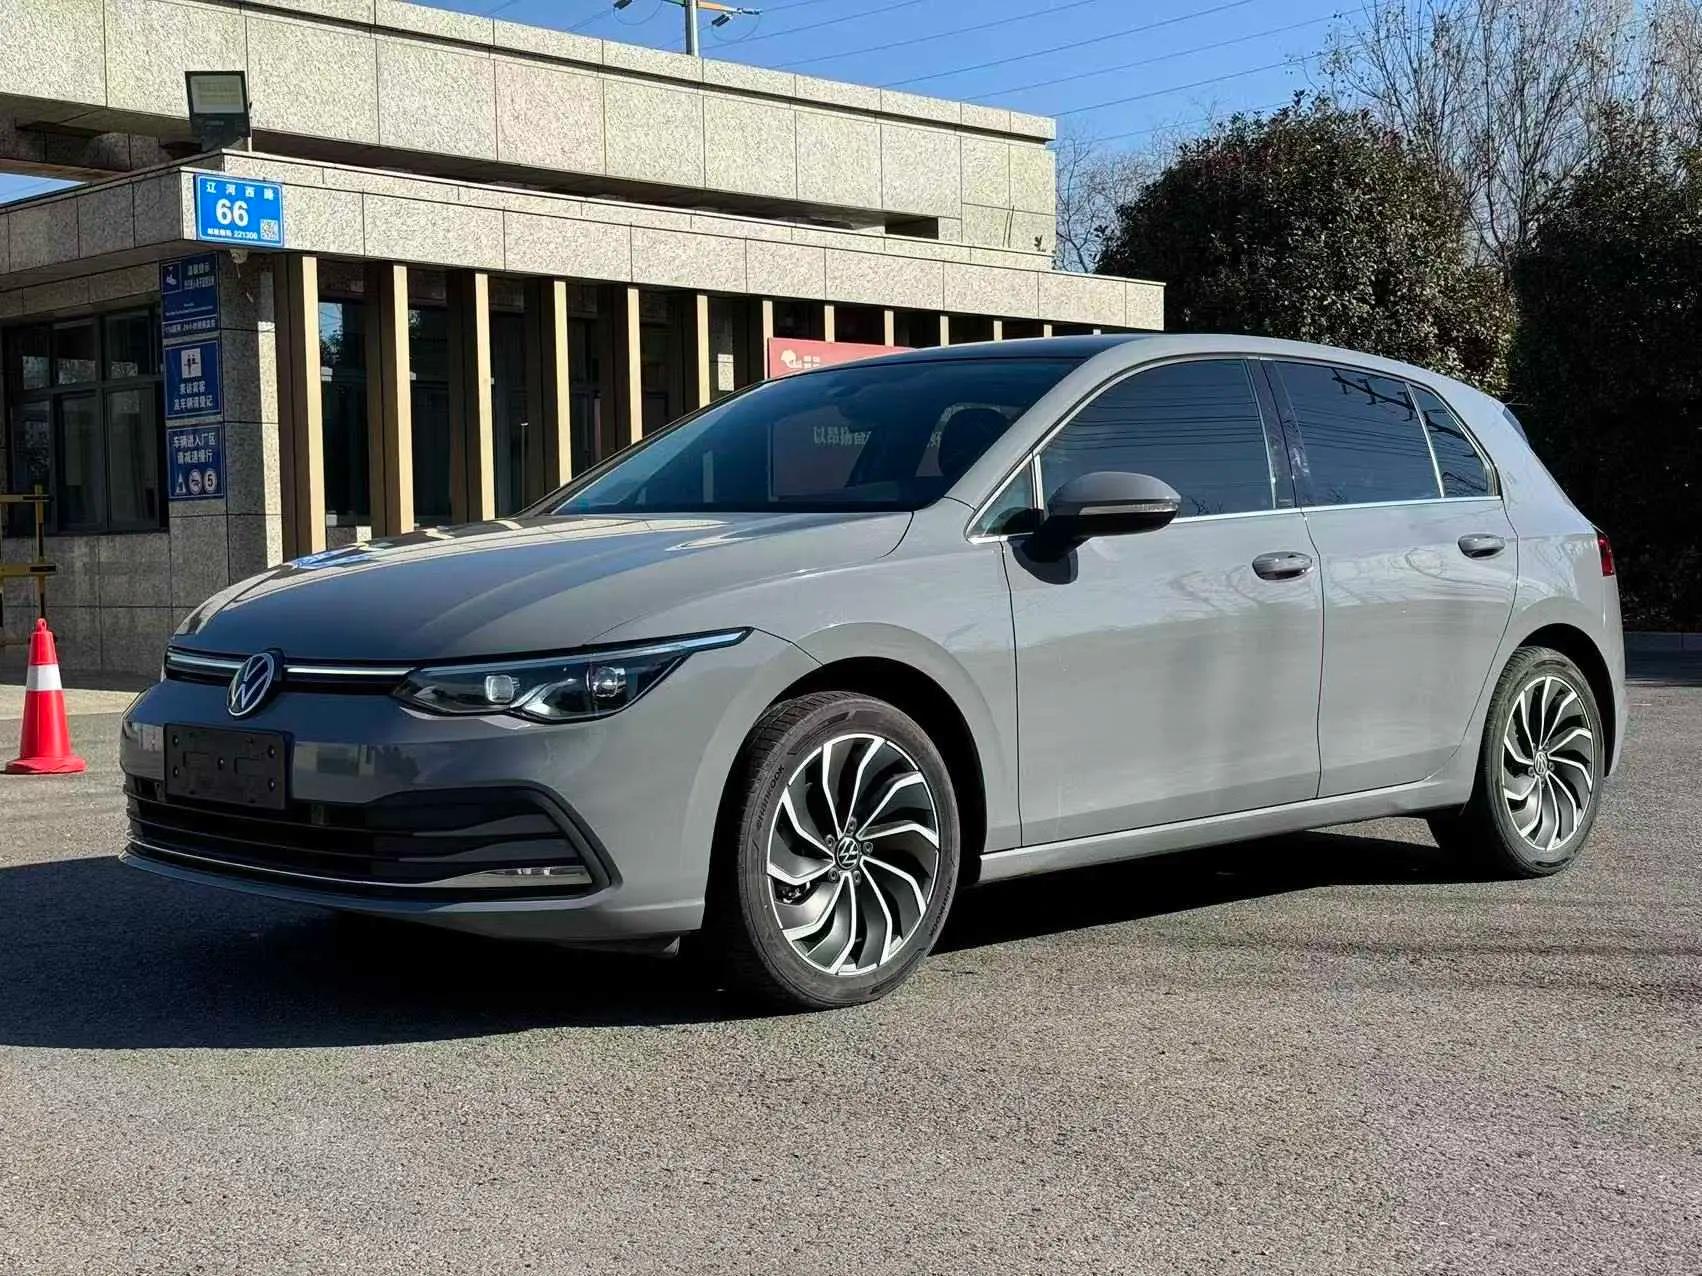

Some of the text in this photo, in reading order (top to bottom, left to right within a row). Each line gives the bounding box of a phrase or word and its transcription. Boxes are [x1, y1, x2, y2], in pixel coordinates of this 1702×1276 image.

[216, 199, 248, 227] 66
[173, 432, 216, 448] 车辆进入厂区
[177, 449, 213, 464] 请减速慢行
[207, 474, 214, 487] 5
